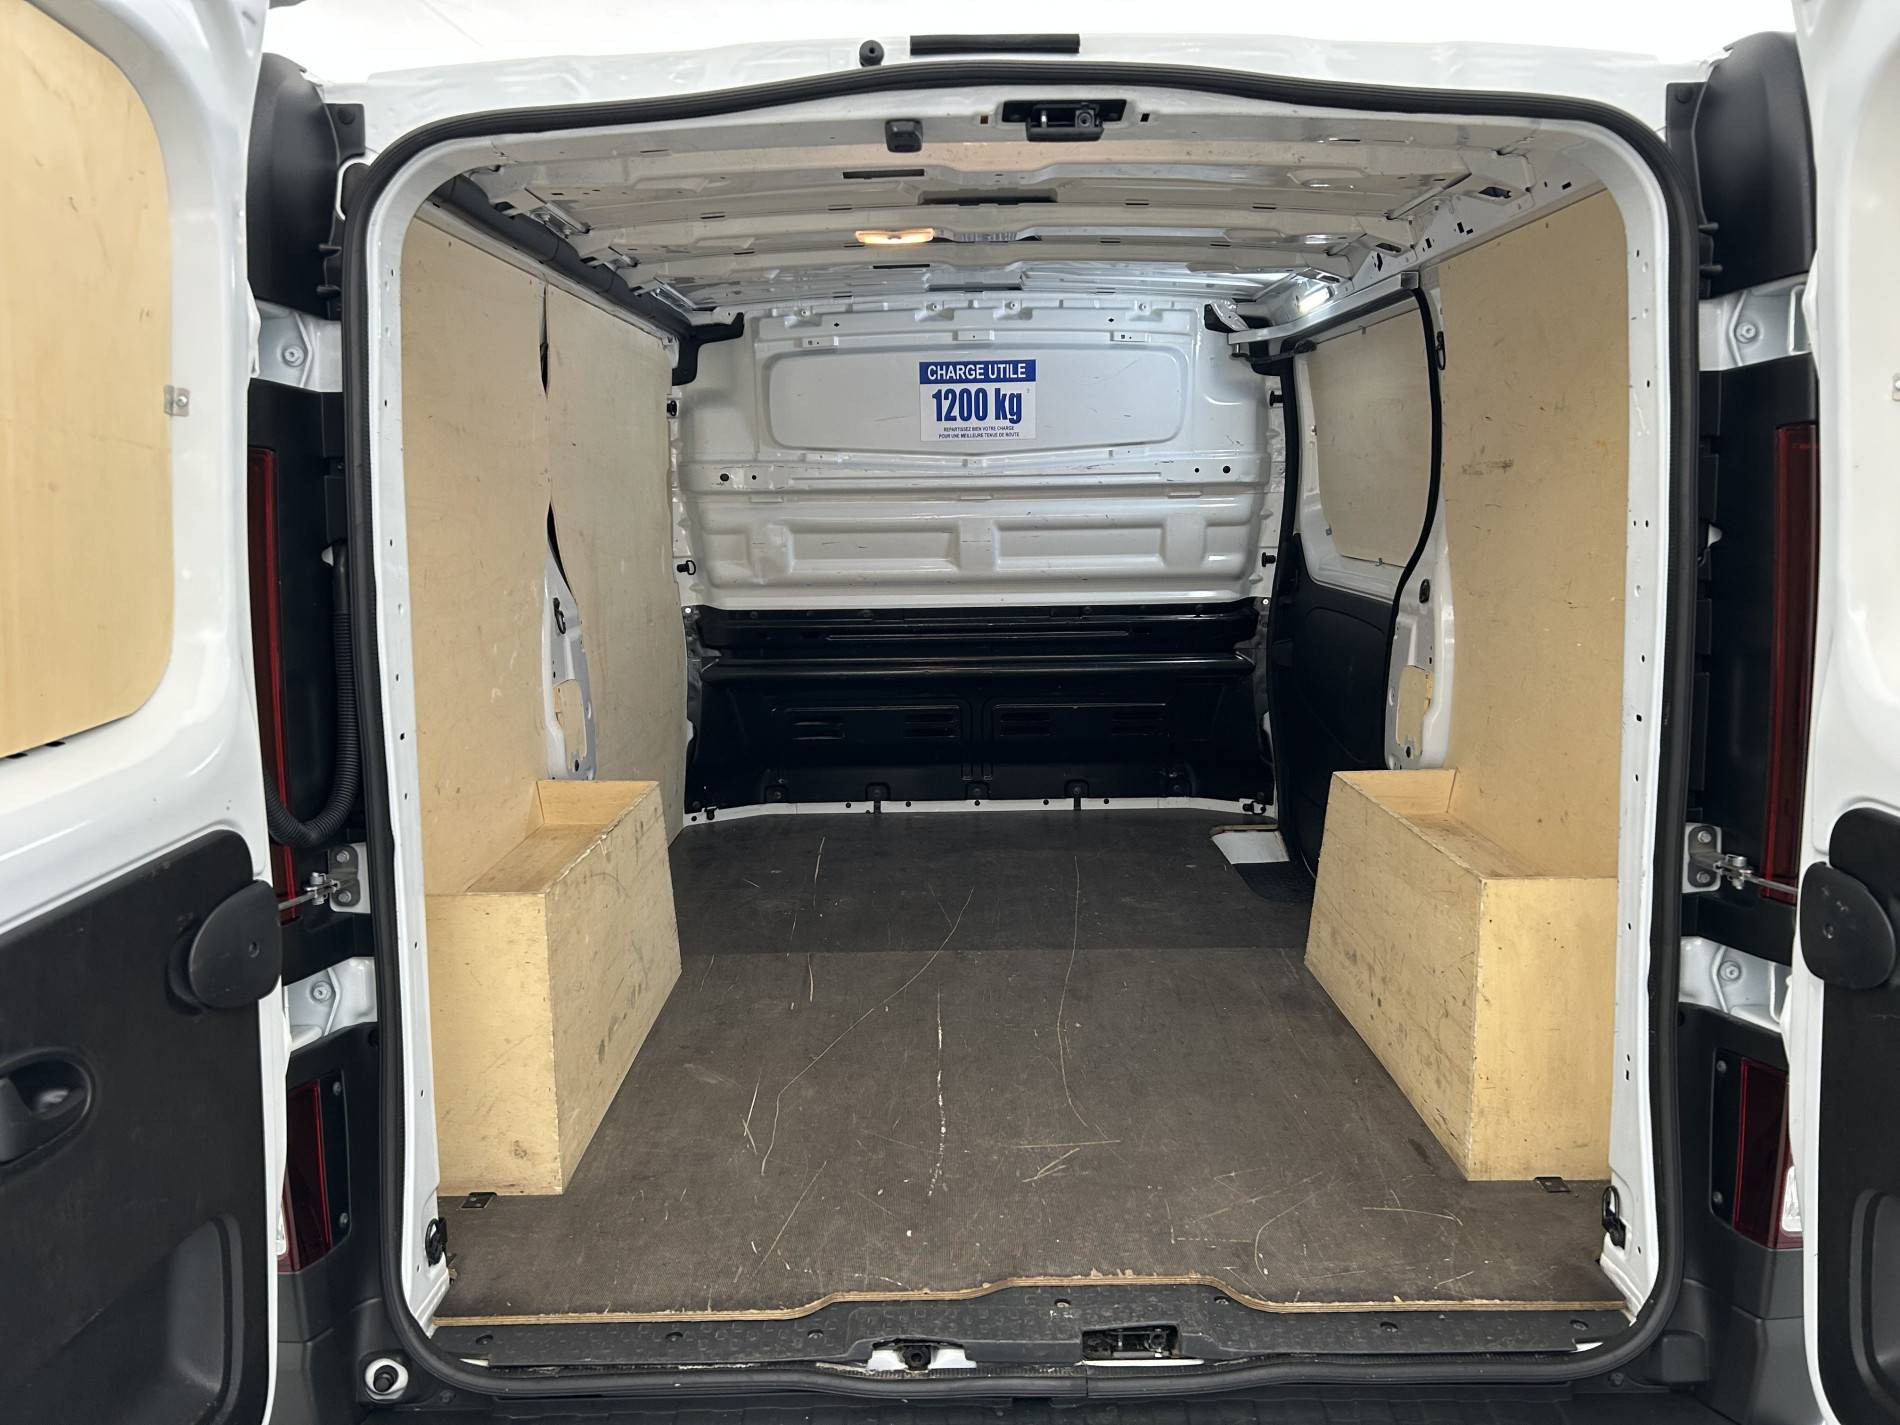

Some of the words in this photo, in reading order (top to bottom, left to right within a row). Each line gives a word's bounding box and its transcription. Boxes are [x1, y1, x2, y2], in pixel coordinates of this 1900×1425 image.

[927, 364, 984, 380] CHARGE
[989, 363, 1026, 378] UTILE
[932, 387, 988, 421] 1200
[995, 387, 1022, 424] kg
